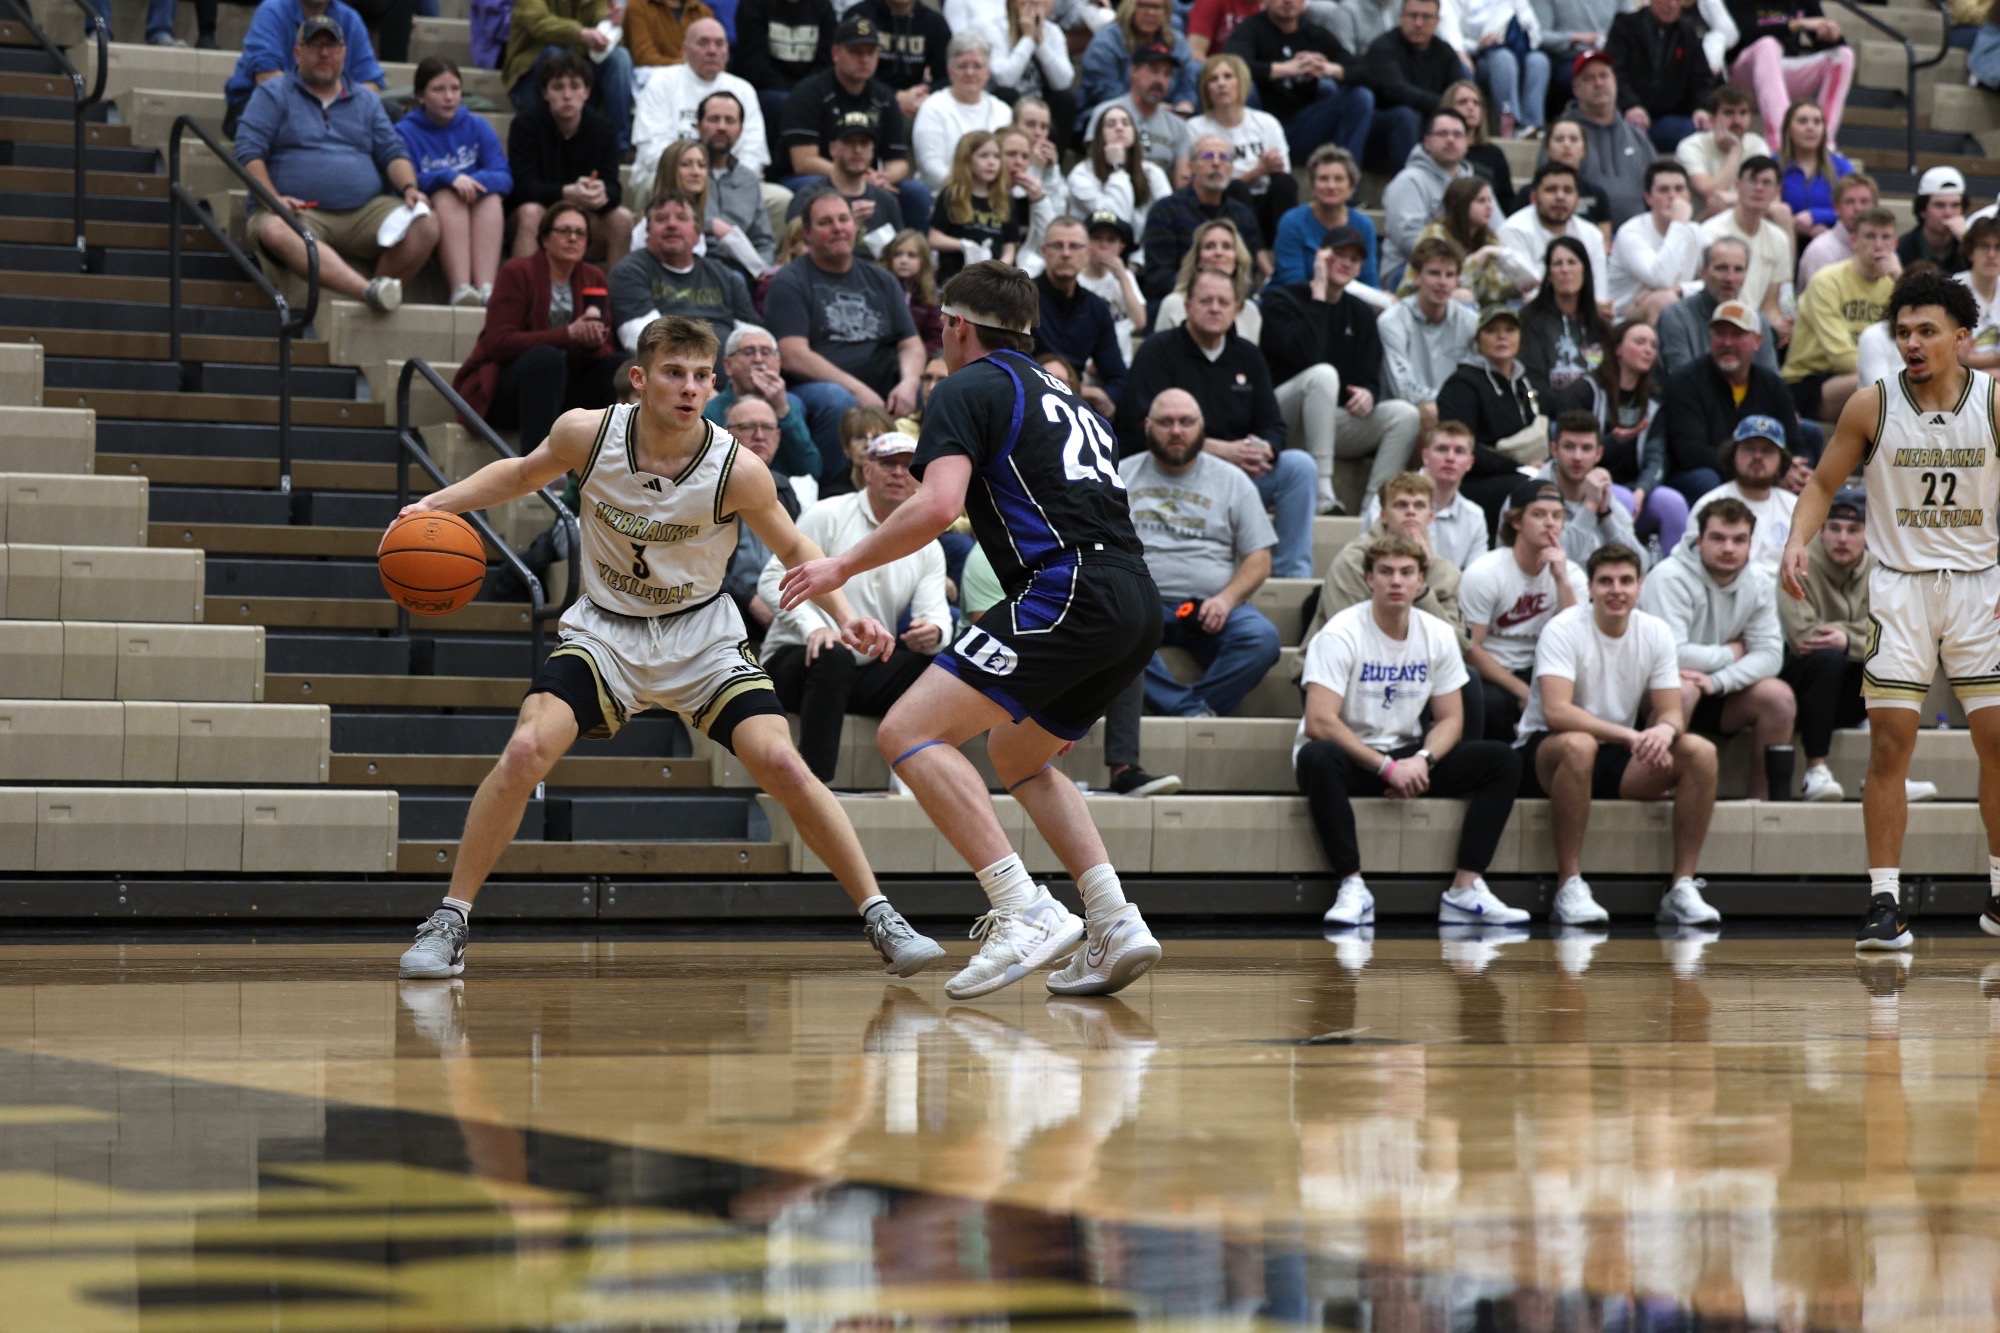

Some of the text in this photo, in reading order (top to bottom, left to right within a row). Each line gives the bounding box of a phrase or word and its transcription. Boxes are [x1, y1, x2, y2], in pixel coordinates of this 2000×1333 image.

[1893, 448, 1986, 468] NEBRASKA
[1921, 472, 1956, 506] 22
[595, 501, 700, 542] NEBRASKA
[1896, 508, 1984, 528] WESLEYAN
[630, 542, 650, 580] 3
[595, 559, 694, 605] WESLEYAN
